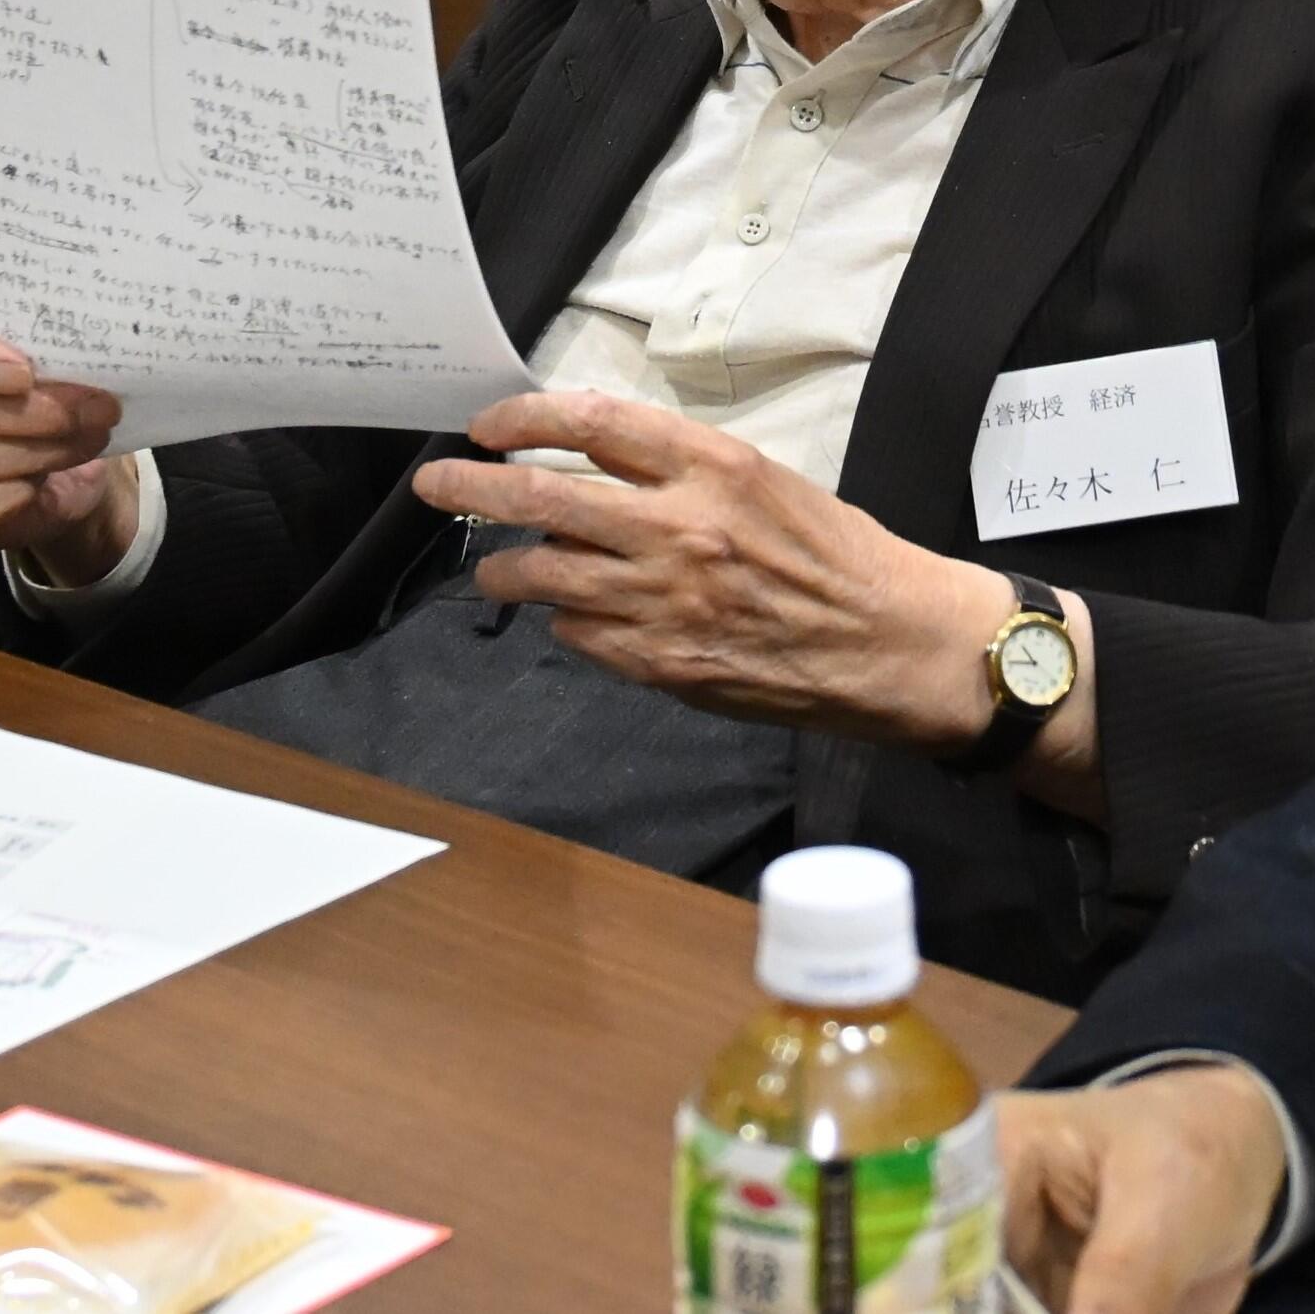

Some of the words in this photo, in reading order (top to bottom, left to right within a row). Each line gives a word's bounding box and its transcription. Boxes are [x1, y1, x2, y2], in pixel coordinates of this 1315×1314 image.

[1089, 384, 1137, 413] 経済
[1007, 467, 1113, 515] 佐々木
[1151, 457, 1186, 493] 仁
